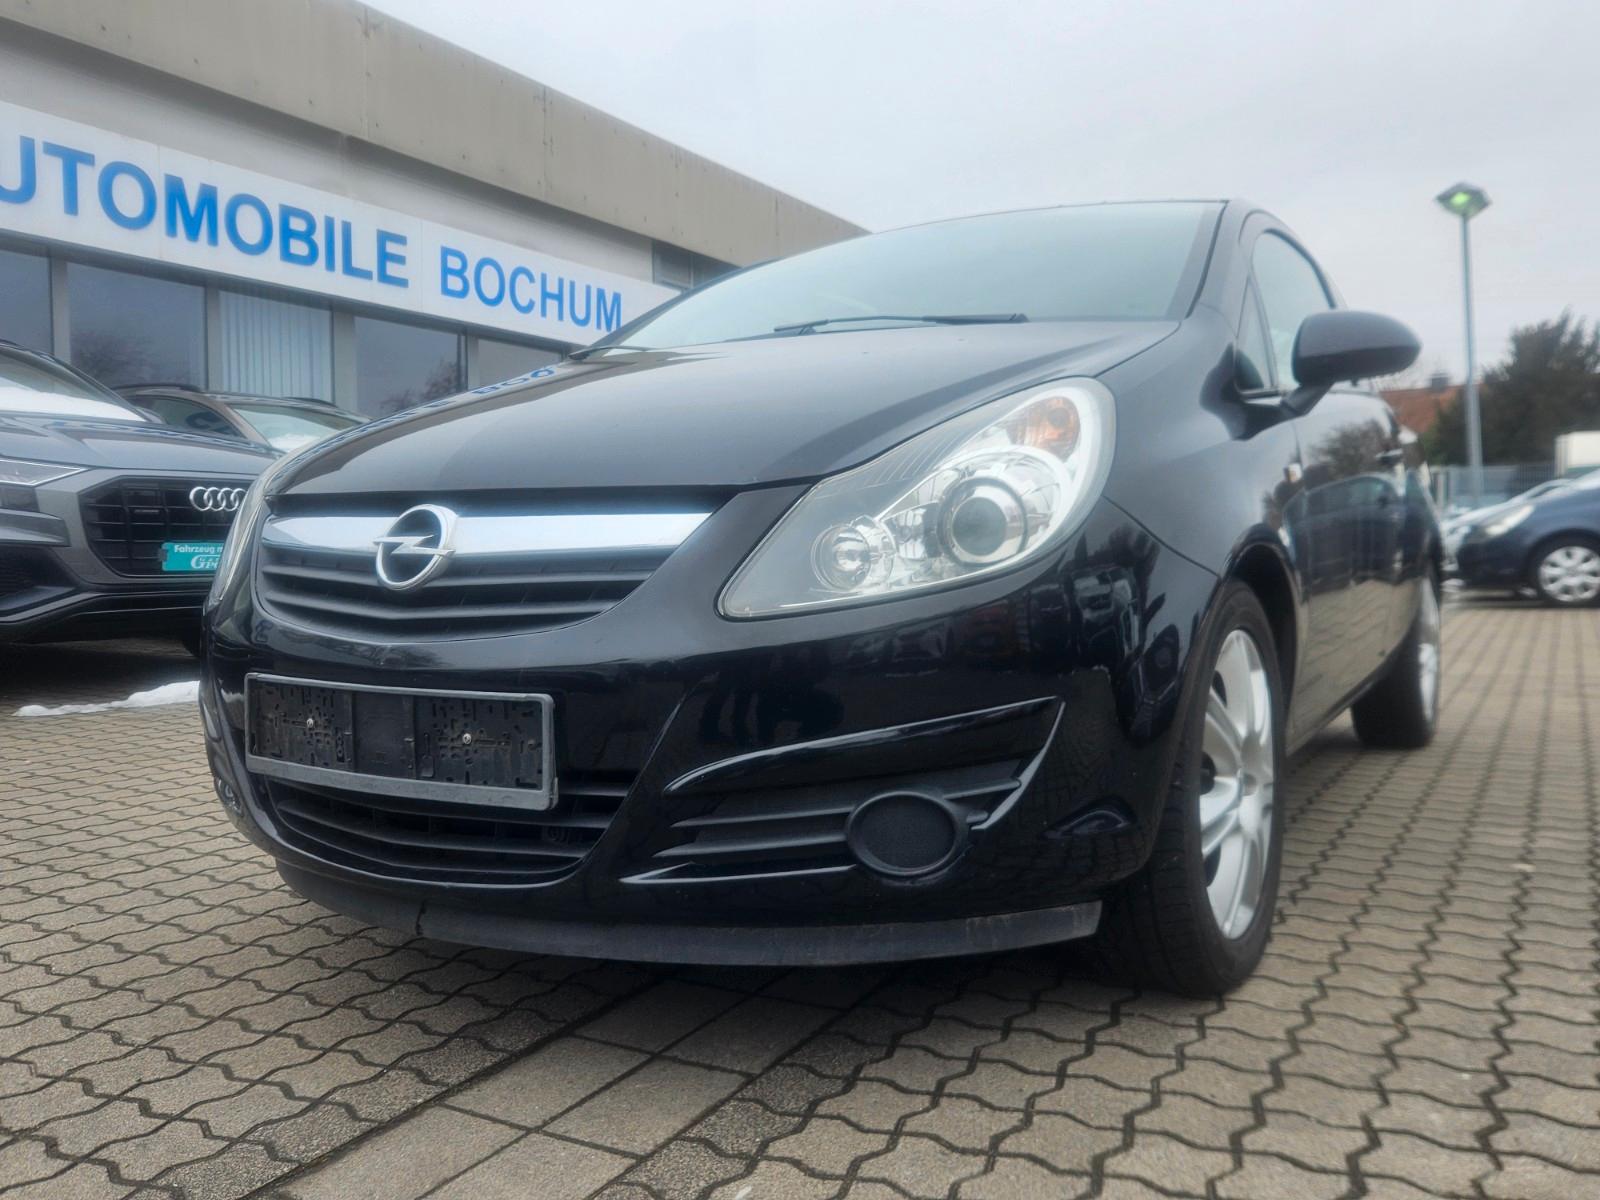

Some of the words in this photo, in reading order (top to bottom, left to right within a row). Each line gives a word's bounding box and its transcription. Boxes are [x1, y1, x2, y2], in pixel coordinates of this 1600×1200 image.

[0, 134, 409, 288] UTOMOBILE
[440, 245, 622, 333] BOCHUM
[174, 544, 215, 554] Fahrzeug
